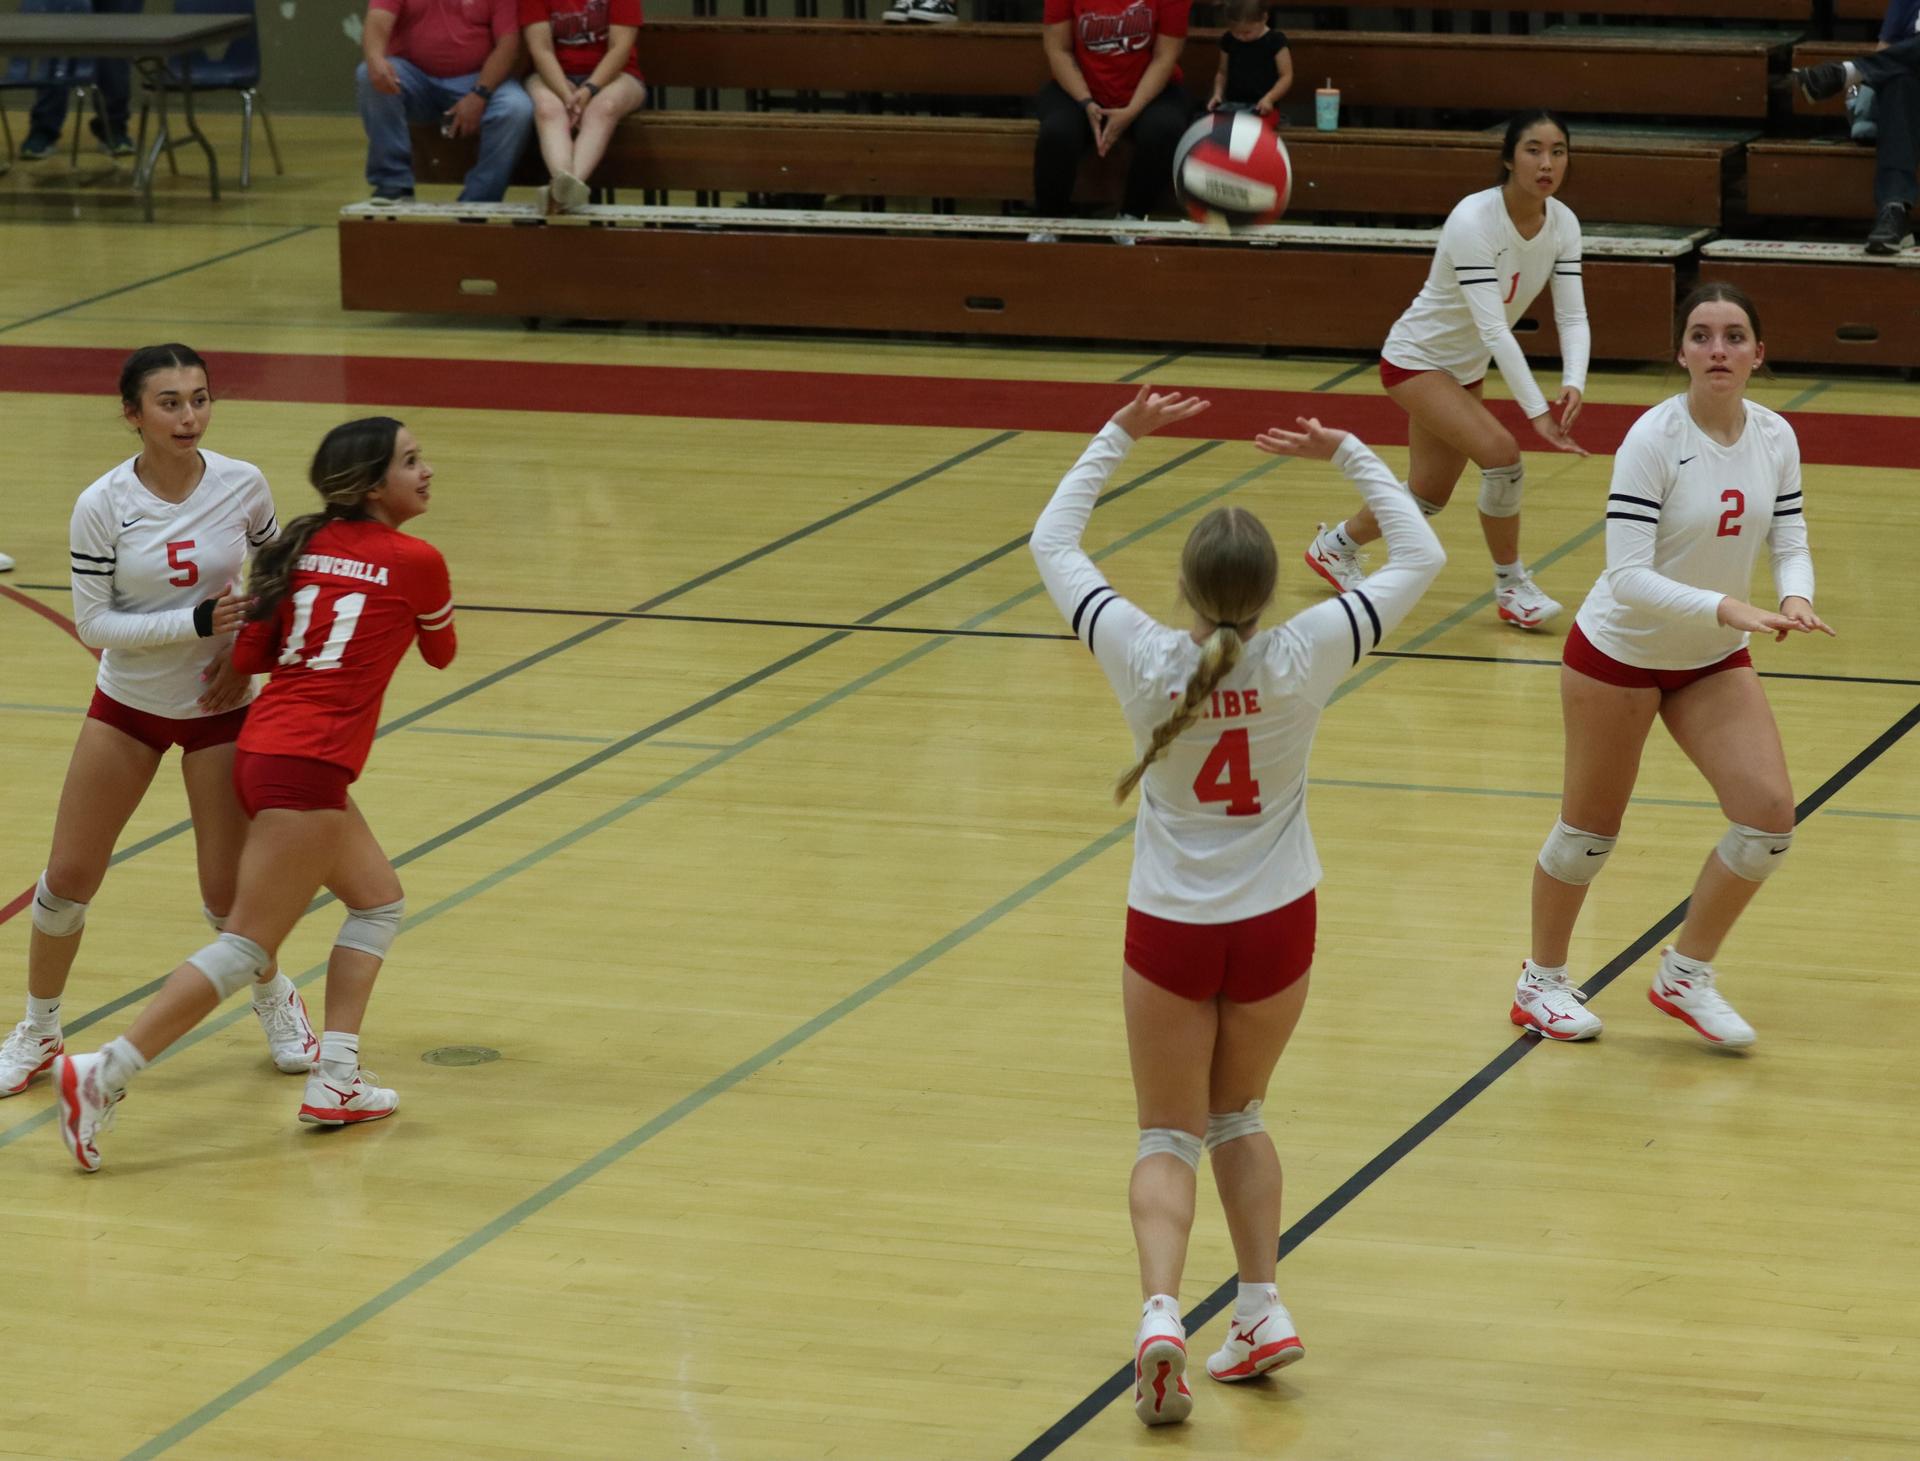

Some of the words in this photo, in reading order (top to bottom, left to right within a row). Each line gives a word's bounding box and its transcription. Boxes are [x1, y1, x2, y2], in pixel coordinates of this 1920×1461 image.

[1503, 271, 1520, 304] 1
[1717, 489, 1745, 537] 2
[166, 540, 199, 587] 5
[295, 554, 390, 586] HOWCHILLA
[278, 584, 368, 671] 11
[1170, 689, 1262, 719] IBE
[1193, 727, 1262, 817] 4
